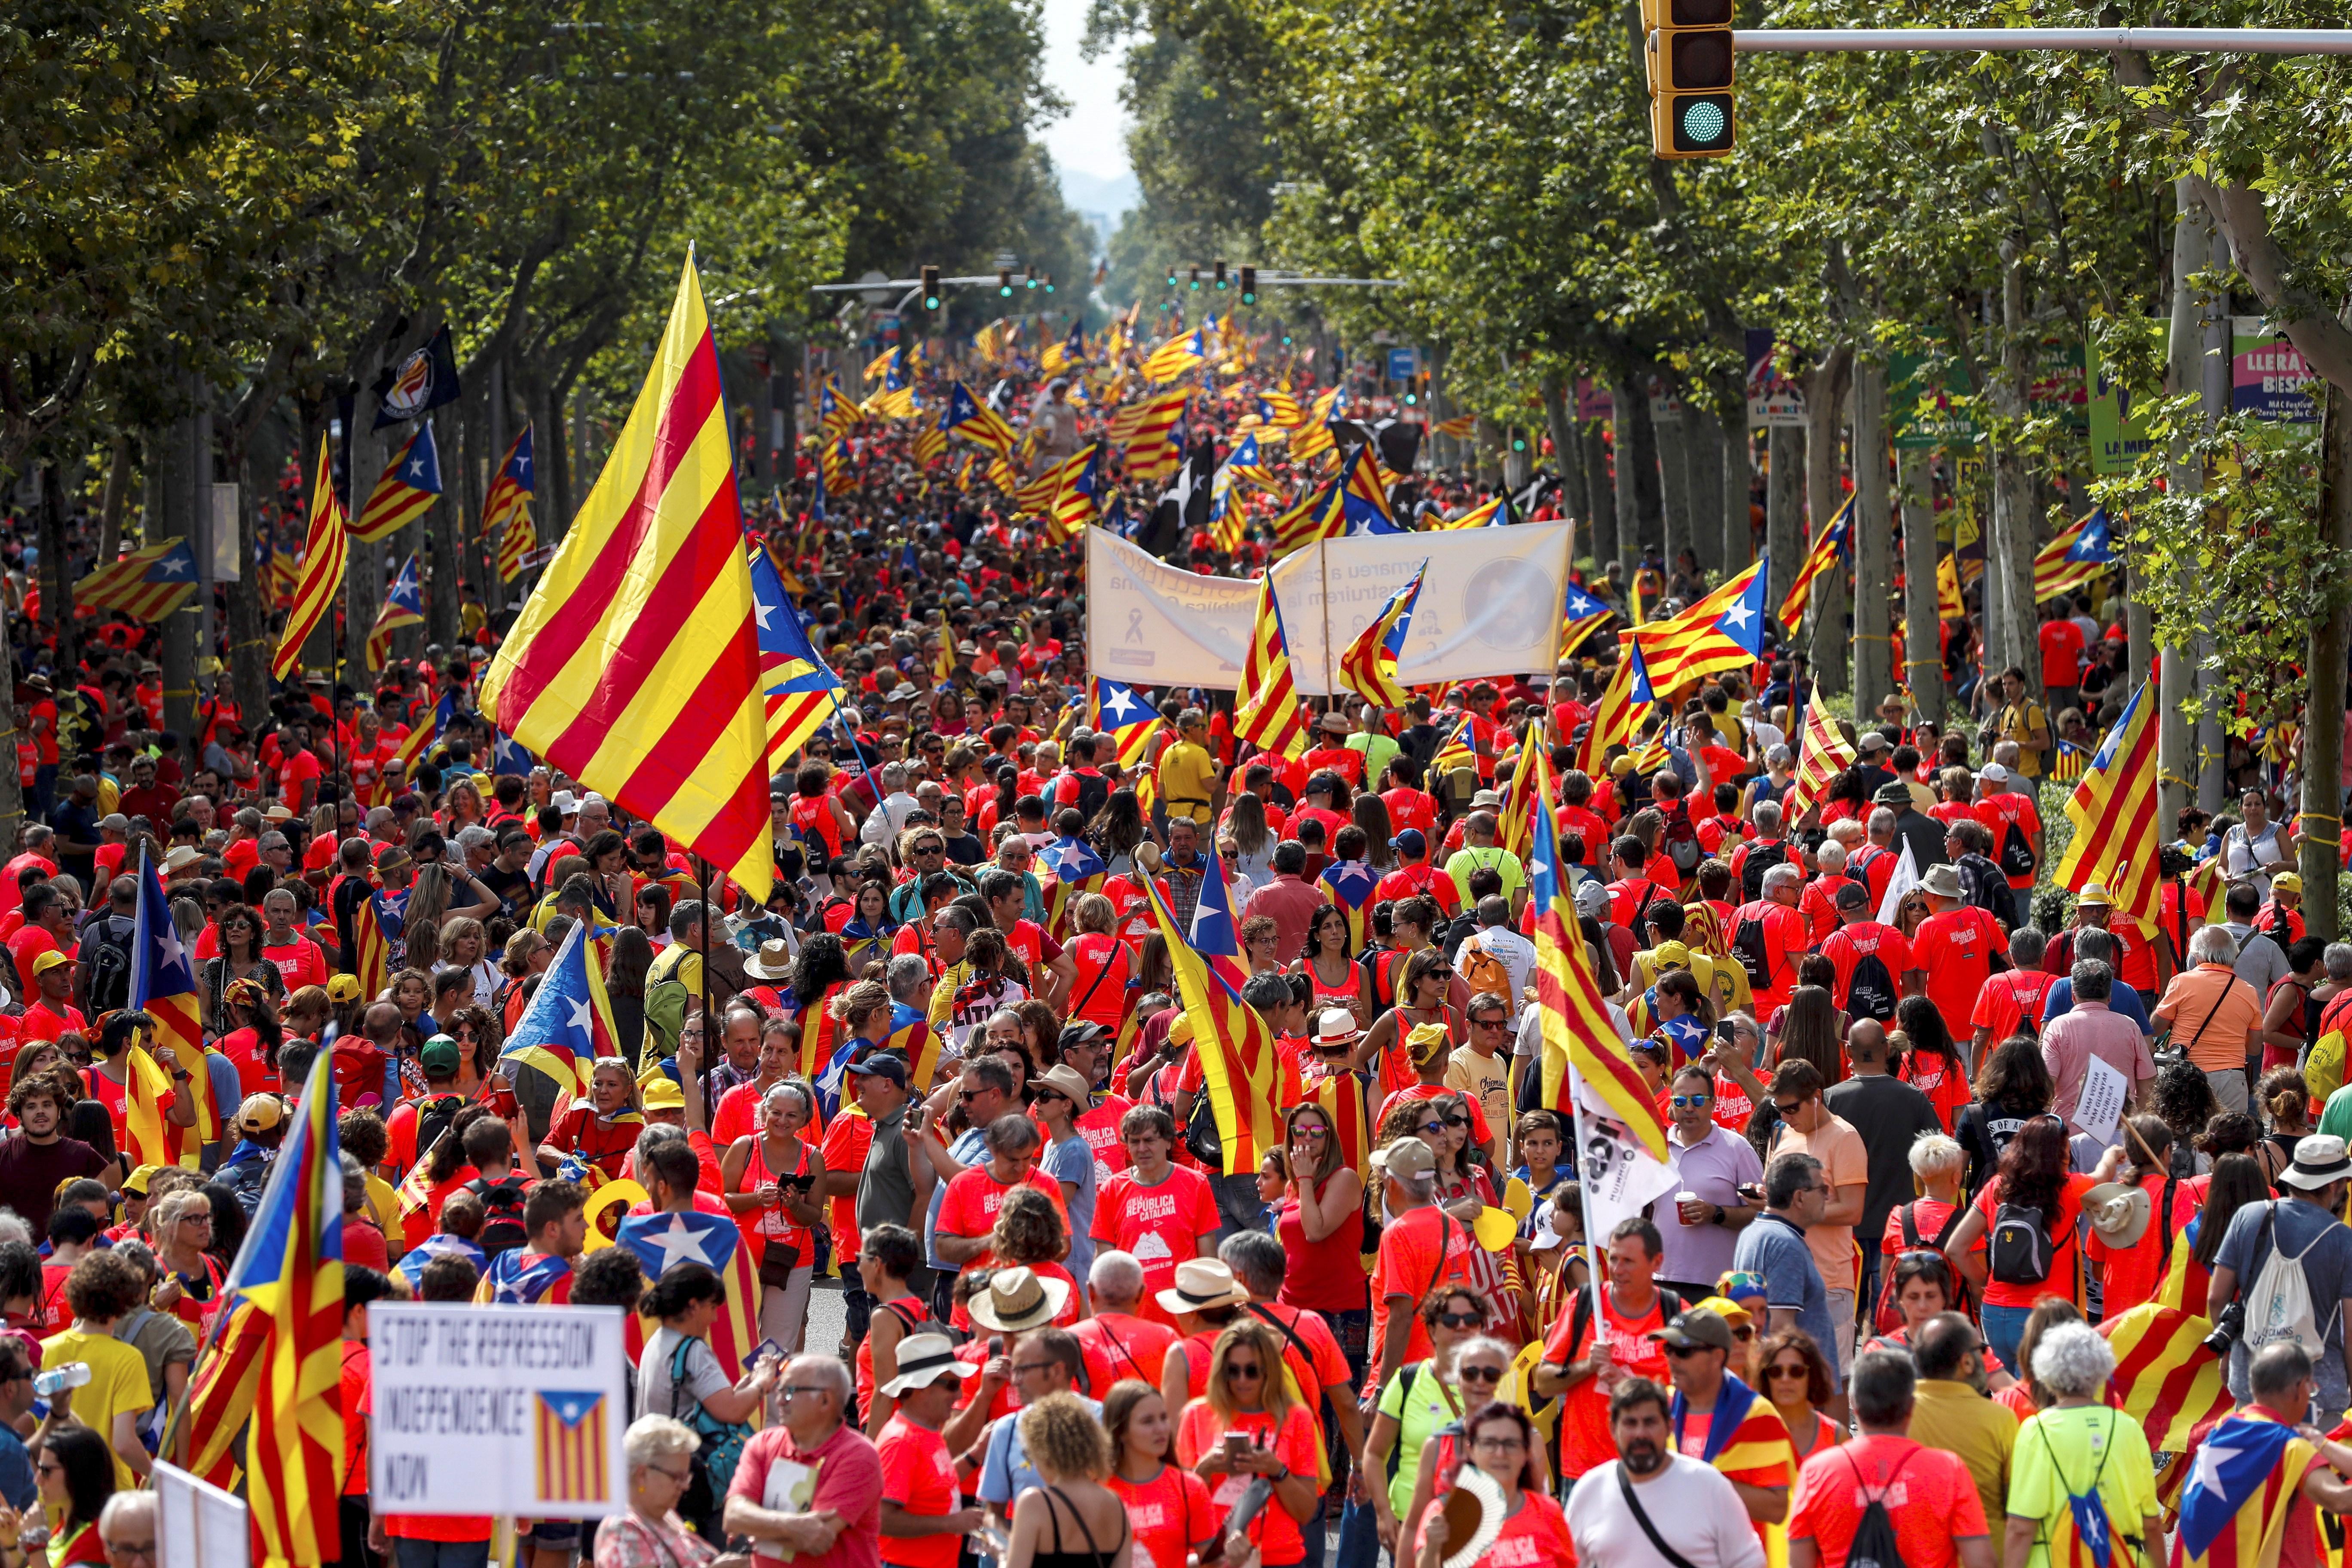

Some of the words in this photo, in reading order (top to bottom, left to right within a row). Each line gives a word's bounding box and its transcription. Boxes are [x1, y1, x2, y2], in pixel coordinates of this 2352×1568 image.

[2248, 353, 2300, 372] LLERA
[1951, 928, 1975, 943] REPÚBLICA
[1958, 933, 1977, 945] CATALANA
[2314, 1054, 2323, 1066] Sí
[1480, 1090, 1488, 1101] &
[2083, 1097, 2093, 1117] VAM
[2089, 1072, 2100, 1097] VOTAR
[2087, 1108, 2099, 1127] VAM
[2096, 1072, 2108, 1108] GUANYAR
[1721, 1104, 1752, 1119] CATALANA
[1998, 1120, 2009, 1130] OF
[984, 1192, 992, 1200] FEM
[1126, 1197, 1135, 1207] FEM
[1136, 1194, 1142, 1205] LA
[1126, 1194, 1175, 1218] REPÚBLICA
[1139, 1206, 1176, 1222] CATALANA
[380, 1316, 431, 1368] STOP
[437, 1317, 473, 1369] THE
[475, 1318, 597, 1371] REPRESSION
[381, 1387, 525, 1436] INDEPENDENCE
[384, 1453, 429, 1501] NOW
